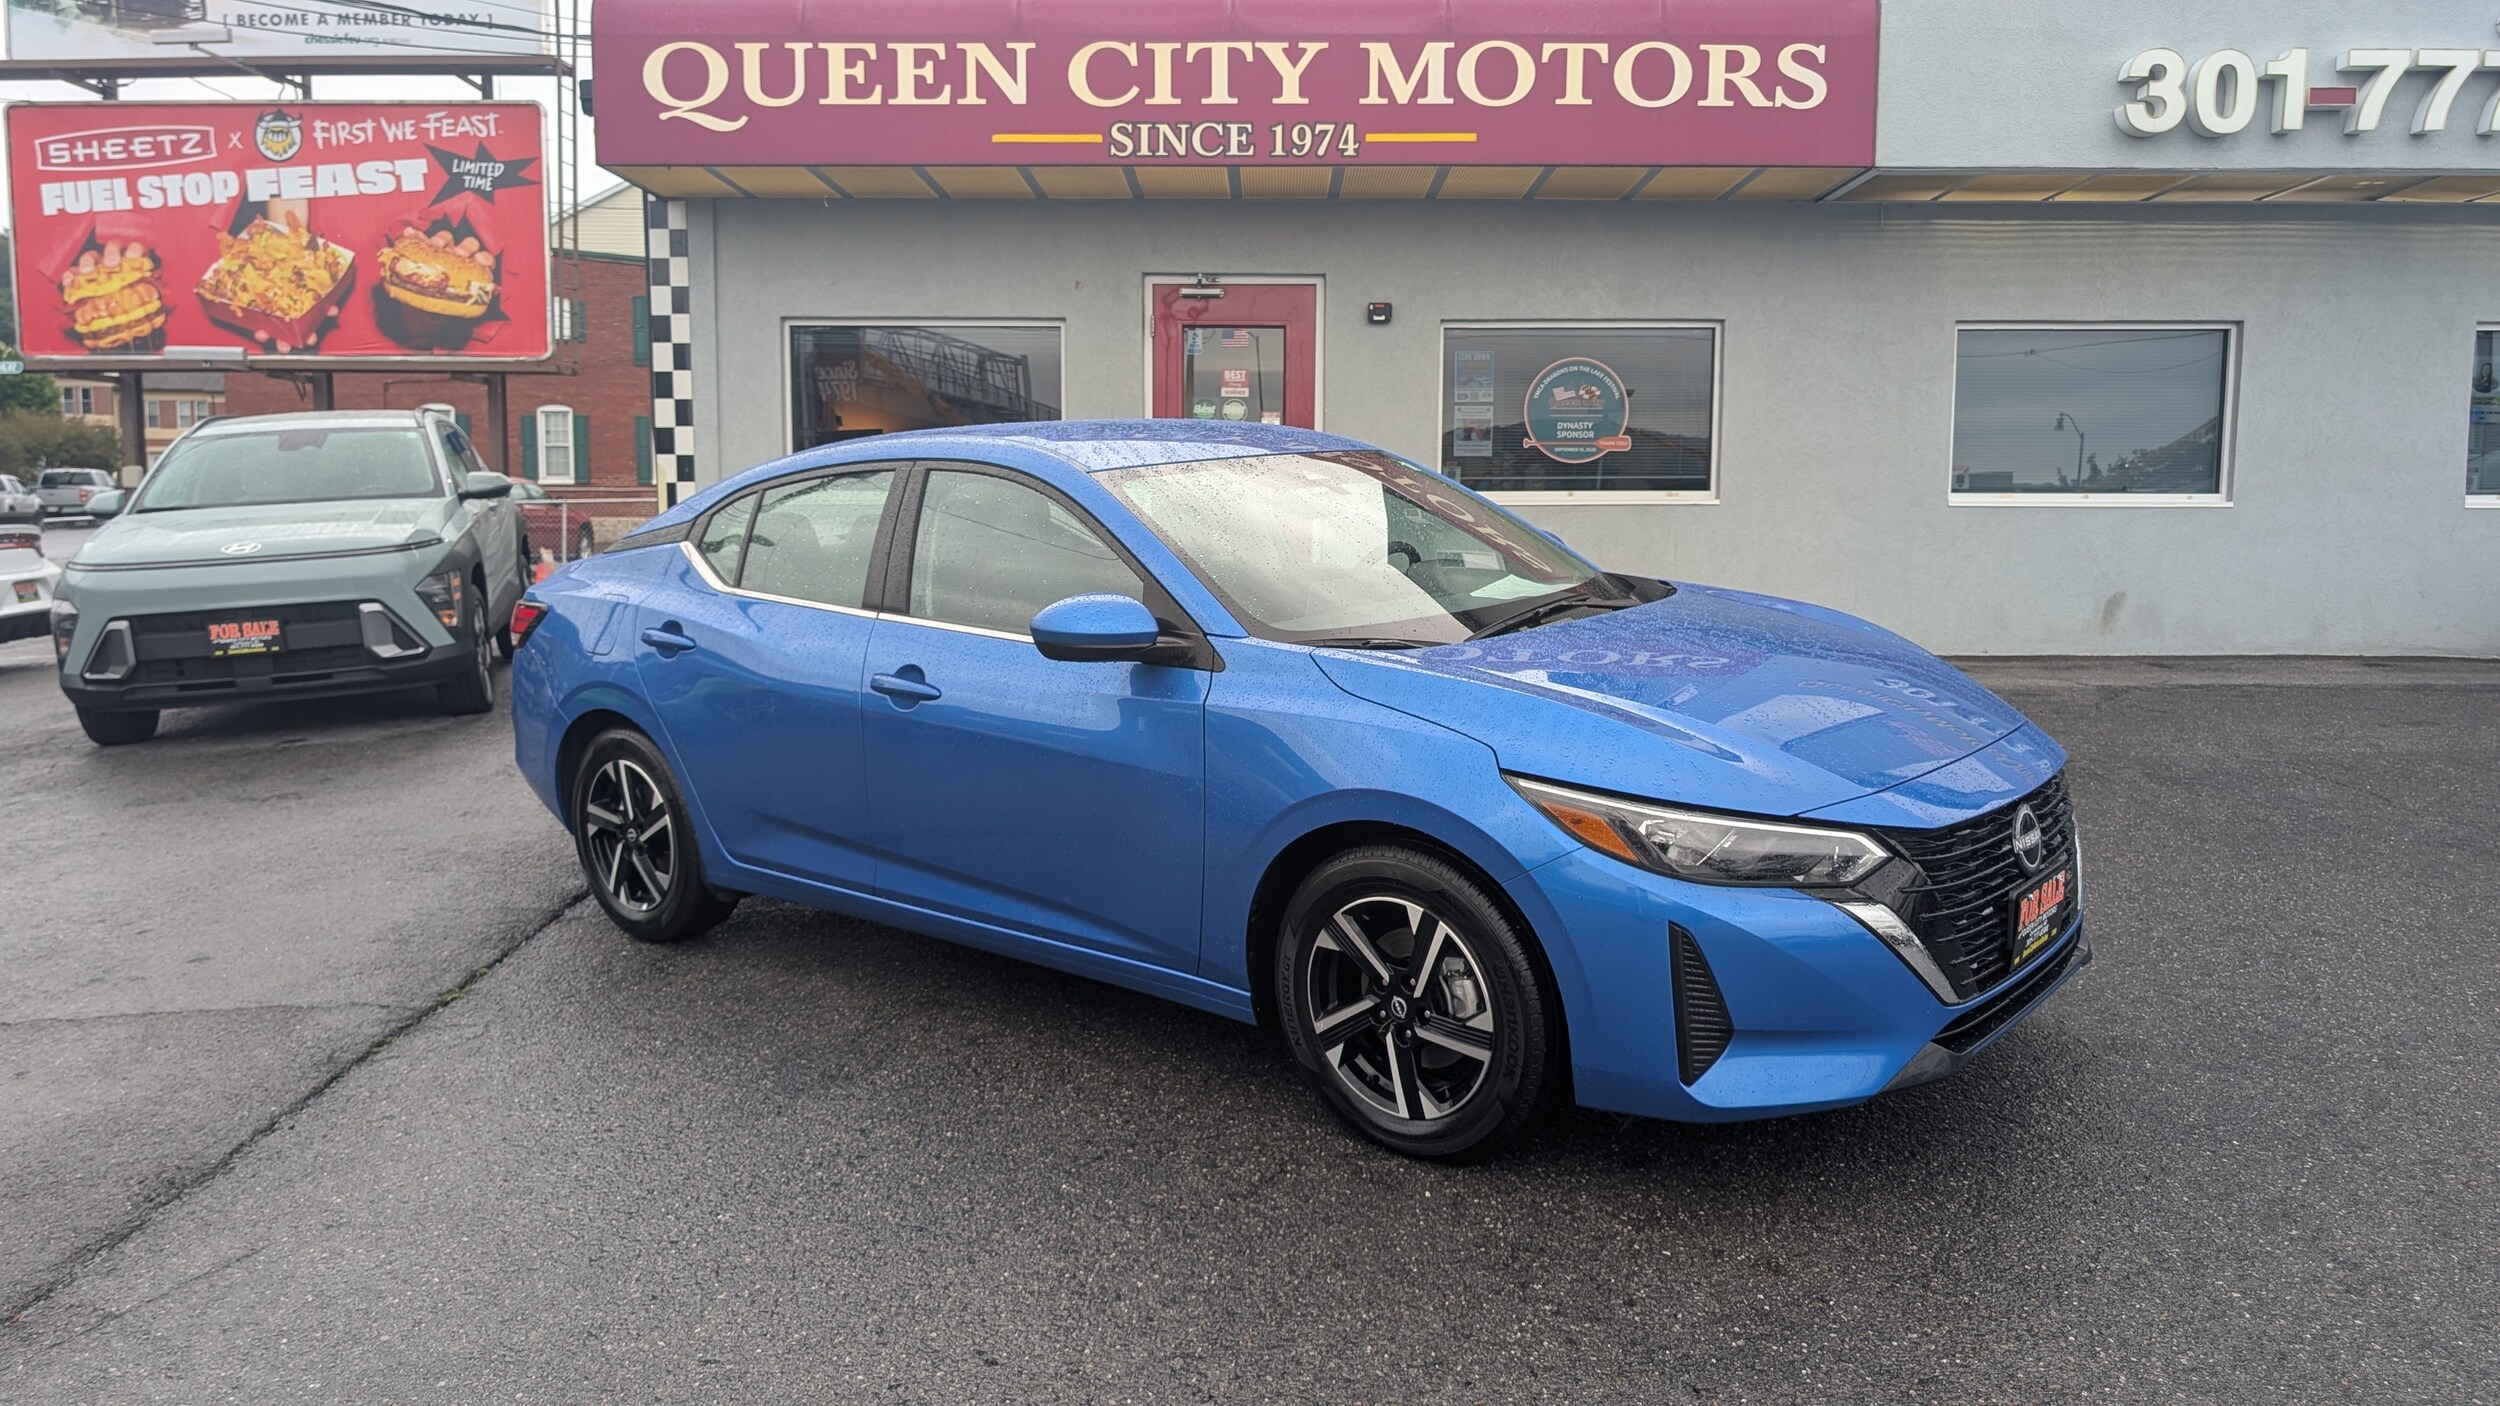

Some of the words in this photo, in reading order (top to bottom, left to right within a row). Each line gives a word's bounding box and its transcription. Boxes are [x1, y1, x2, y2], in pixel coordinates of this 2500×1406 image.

[237, 13, 309, 27] BECOME
[317, 13, 330, 26] A
[336, 13, 412, 27] MEMBER
[419, 13, 479, 27] TODAY
[642, 41, 1036, 133] QUEEN
[1067, 40, 1329, 108] CITY
[1358, 40, 1829, 110] MOTORS
[311, 117, 377, 150] FIRST
[380, 117, 418, 143] WE
[420, 111, 500, 141] FEAST
[1108, 120, 1255, 159] SINCE
[1269, 120, 1360, 158] 1974
[48, 132, 204, 164] SHEETZ
[452, 158, 506, 178] LIMITED
[40, 177, 134, 216] FUEL
[137, 171, 240, 209] STOP
[245, 158, 428, 202] FEAST
[462, 175, 494, 192] TIME
[1224, 370, 1247, 379] BEST
[1543, 367, 1569, 385] DRAGONS
[1579, 365, 1589, 373] THE
[1590, 368, 1603, 379] LAKE
[1602, 376, 1621, 400] FESTIVAL
[1556, 431, 1595, 439] SPONSOR
[1557, 422, 1593, 430] DYNASTY
[209, 622, 241, 640] FOR
[242, 620, 280, 637] SALE
[2017, 889, 2040, 932] FOR
[2039, 869, 2067, 915] SALE
